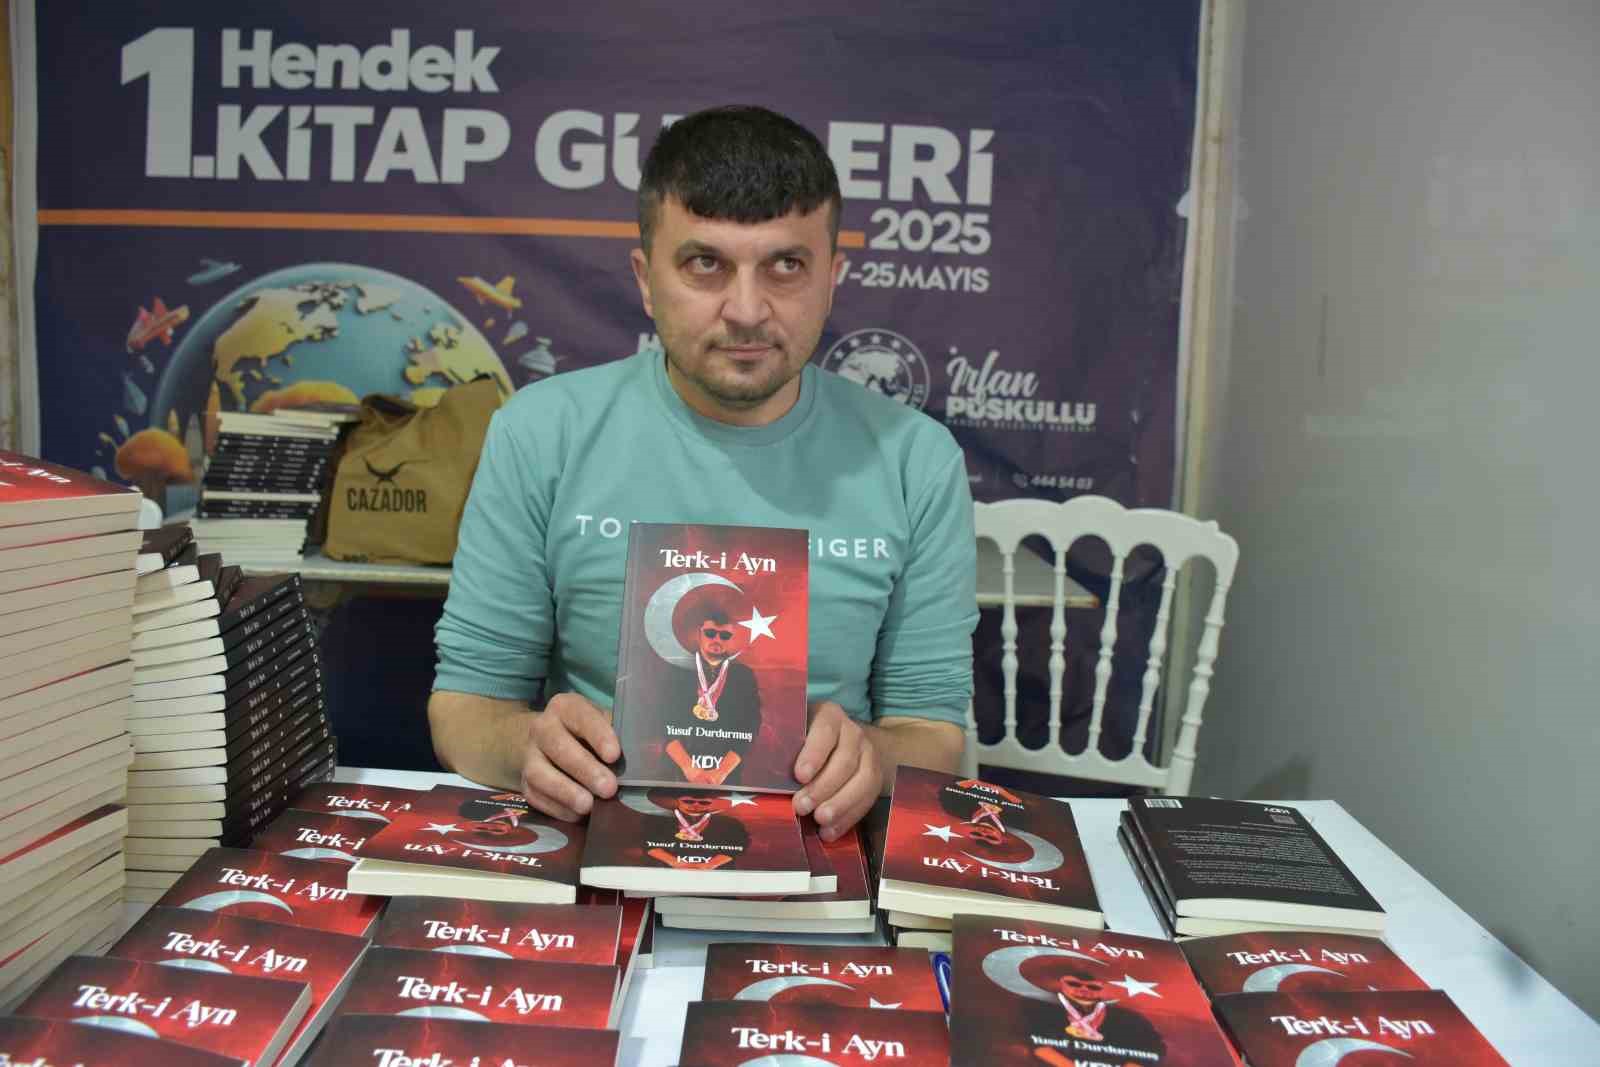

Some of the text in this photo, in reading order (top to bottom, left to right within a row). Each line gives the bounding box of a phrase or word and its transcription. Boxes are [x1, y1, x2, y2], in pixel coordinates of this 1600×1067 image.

[221, 28, 501, 93] Hendek
[120, 27, 216, 178] 1.
[217, 105, 995, 206] KİTAP GÜERİ
[869, 208, 992, 254] 2025
[898, 264, 990, 292] MAYIS
[347, 488, 427, 512] CAZADOR
[660, 548, 776, 576] Terk-i Ayn
[666, 725, 753, 743] Yusuf Durdurmuş
[326, 795, 391, 812] Terk-i
[295, 828, 366, 851] Terk-i
[404, 842, 542, 868] Terk-i Ayn
[217, 868, 350, 902] Terk-i Ayn
[922, 855, 1060, 891] Terk-i Ayn
[423, 920, 576, 951] Terk-i Ayn
[993, 928, 1146, 960] Terk-i Ayn
[162, 931, 310, 974] Terk-i Ayn
[1226, 948, 1369, 966] Terk-i Ayn
[745, 959, 893, 978] Terk-i Ayn
[72, 985, 238, 1029] Terk-i Ayn
[396, 975, 564, 1015] Terk-i Ayn
[1031, 1034, 1069, 1048] Yusuf
[1270, 1015, 1436, 1041] Terk-i Ayn
[731, 1027, 906, 1061] Terk-i Ayn
